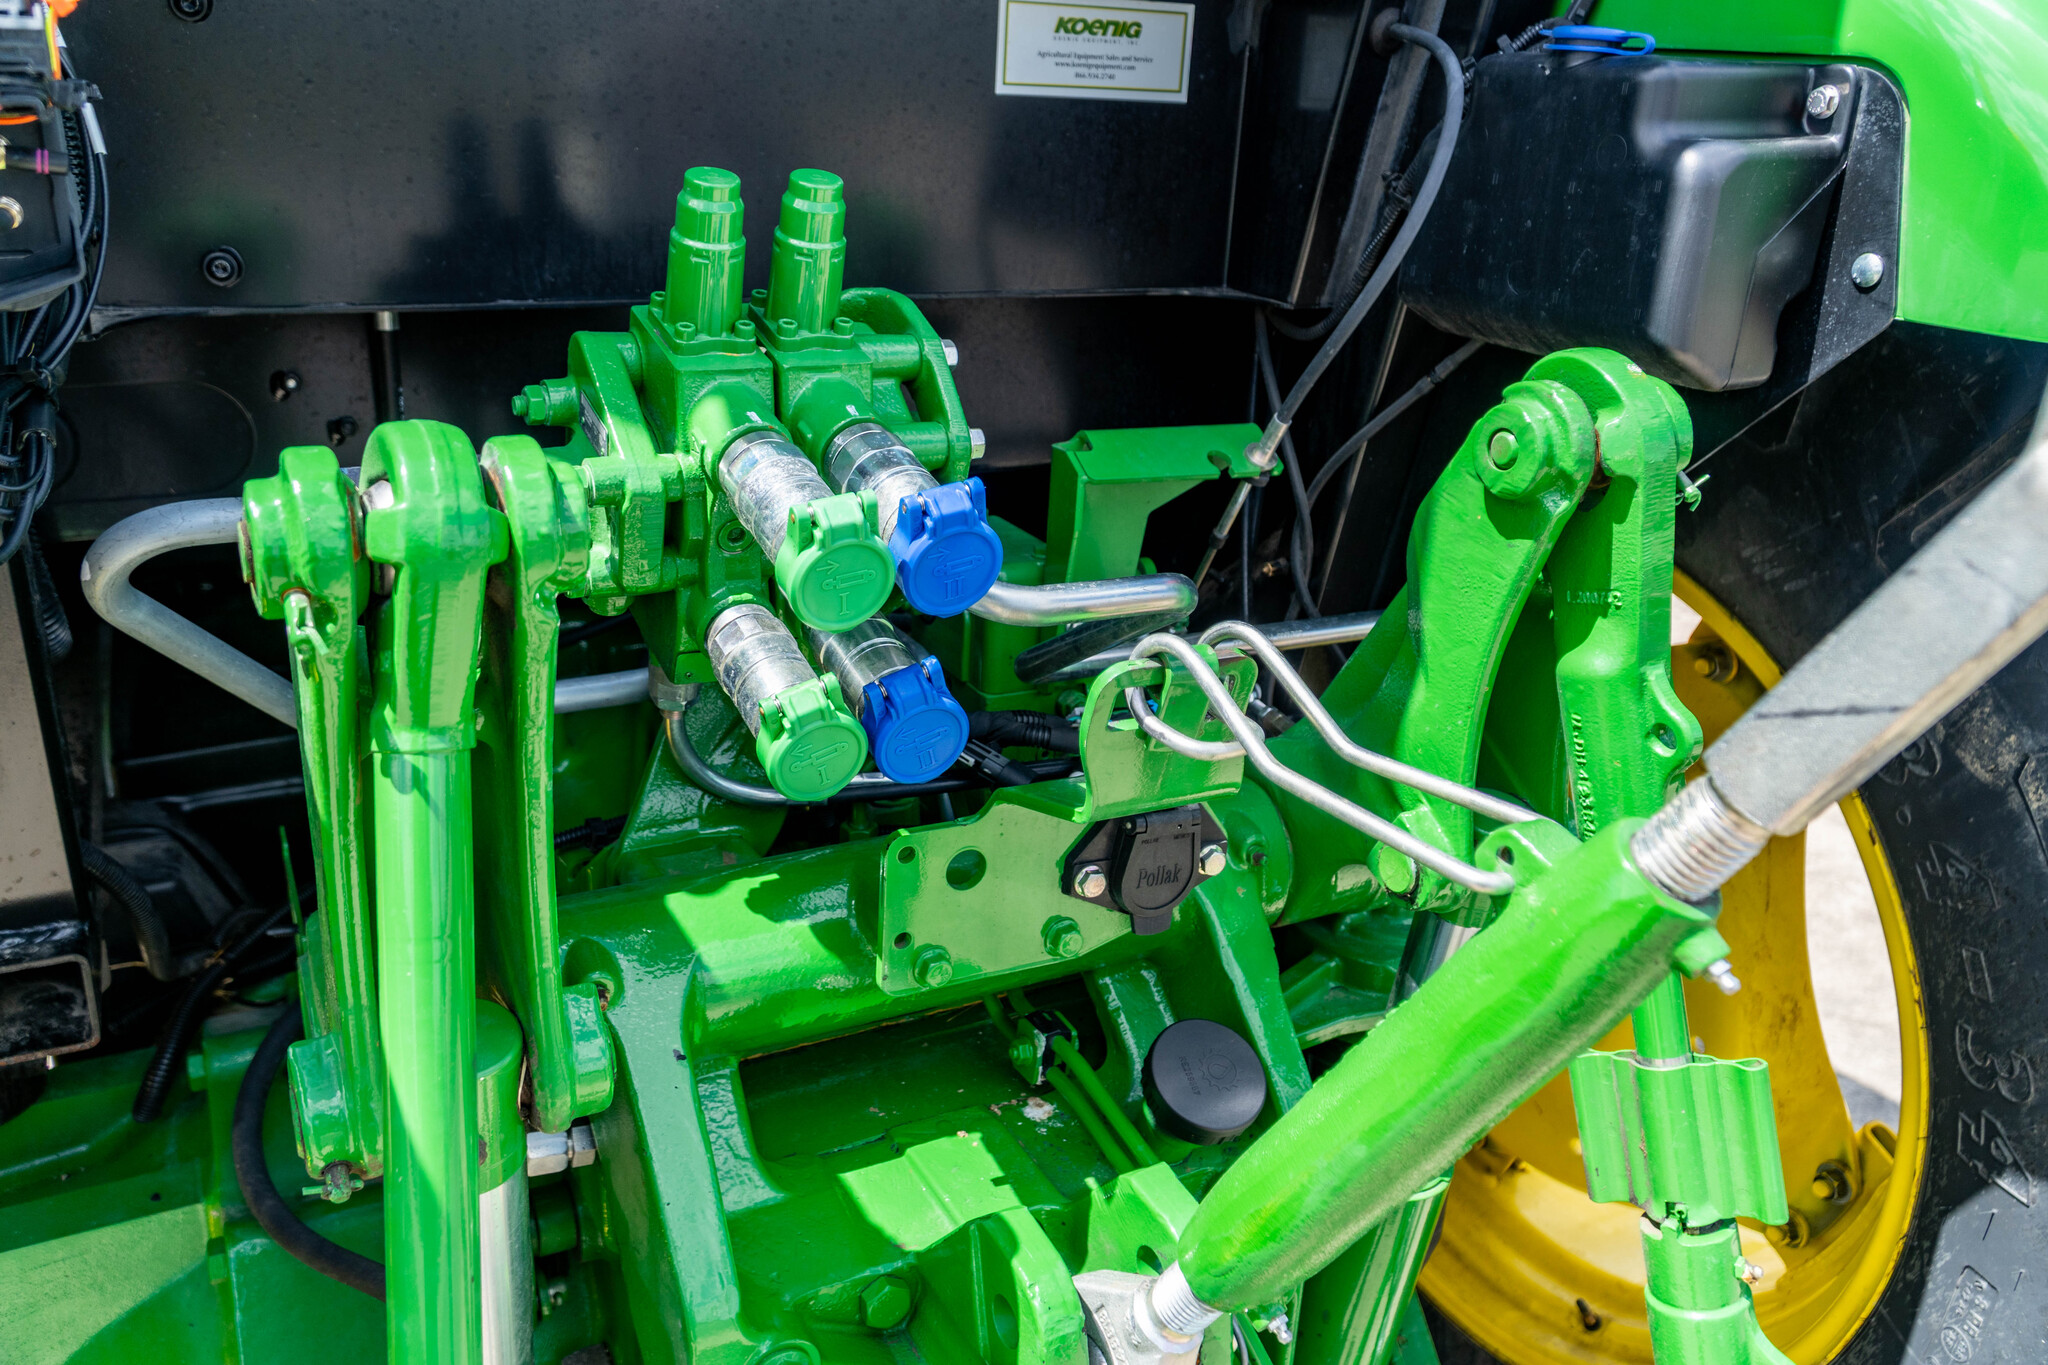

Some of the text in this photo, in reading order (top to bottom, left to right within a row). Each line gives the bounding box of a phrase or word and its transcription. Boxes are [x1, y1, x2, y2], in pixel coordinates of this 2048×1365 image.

[1037, 51, 1073, 59] Agricultural
[1074, 52, 1105, 61] Equipment
[1105, 54, 1121, 62] Sales
[1133, 56, 1154, 64] Service
[1055, 61, 1137, 71] www.koenigequipment.com
[1136, 863, 1182, 889] Pollak
